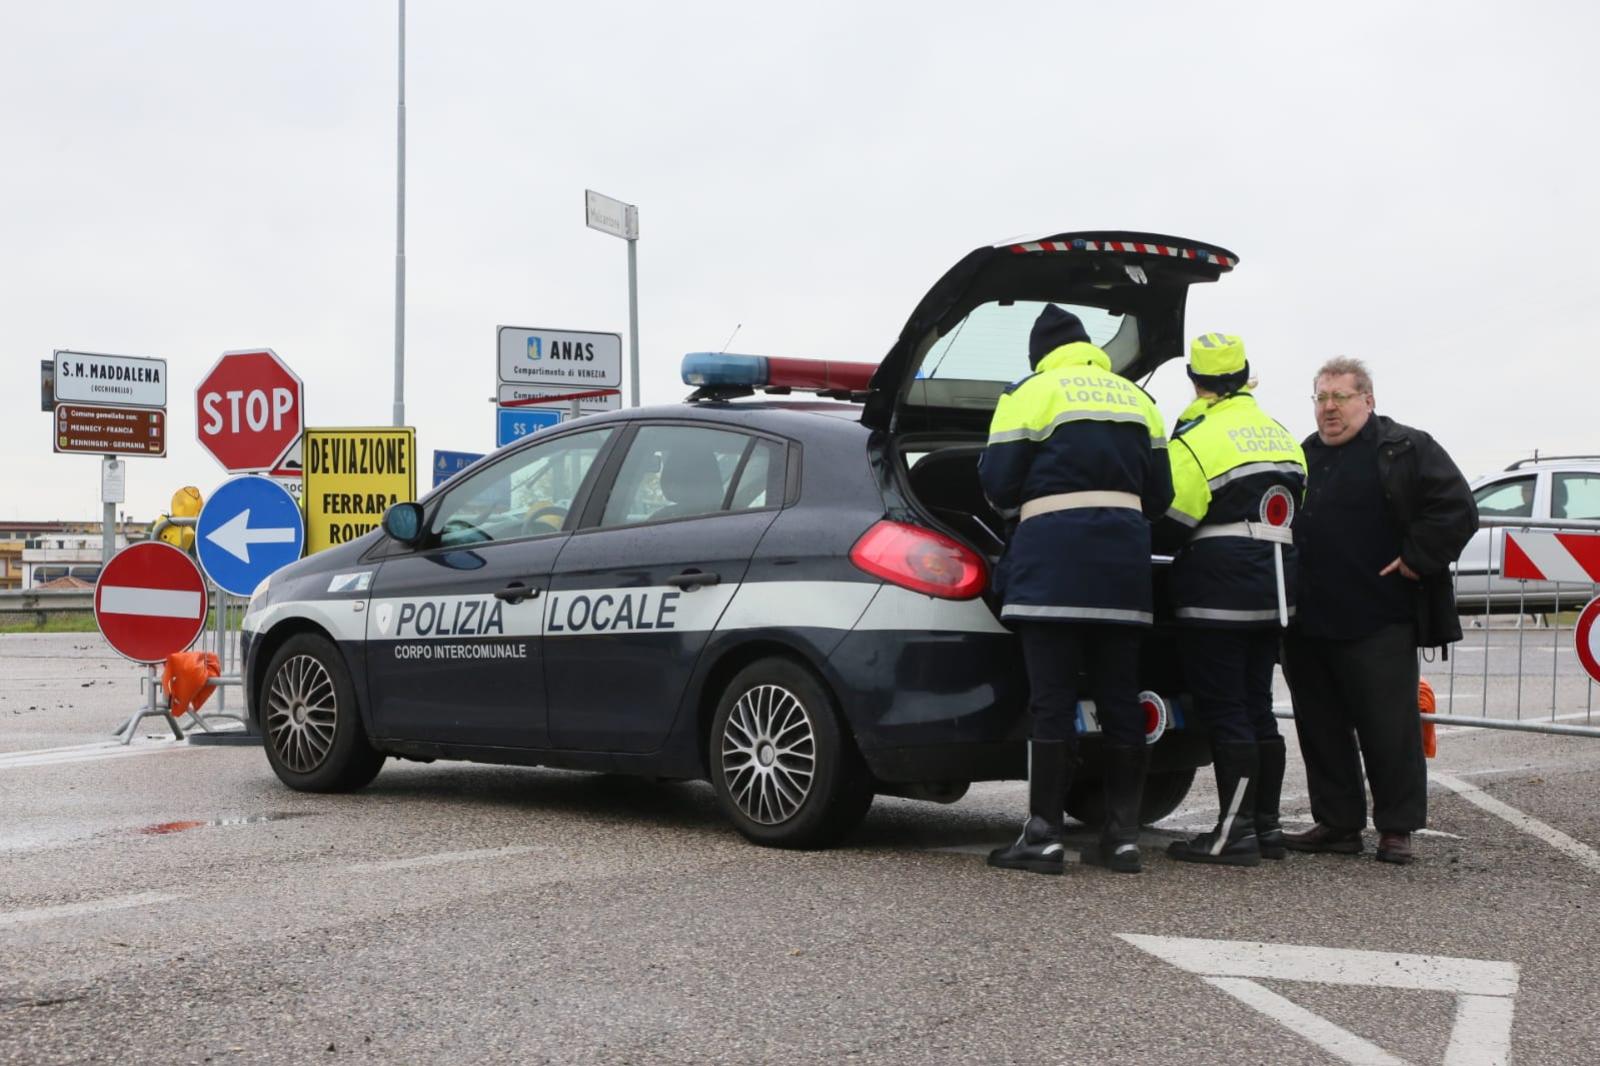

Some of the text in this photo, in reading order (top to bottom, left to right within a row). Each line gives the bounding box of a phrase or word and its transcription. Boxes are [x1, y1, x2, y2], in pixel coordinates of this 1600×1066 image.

[550, 340, 594, 361] ANAS
[513, 366, 606, 378] Compartimento di VENEZIA
[1060, 377, 1131, 391] POLIZIA
[1066, 390, 1138, 407] LOCALE
[71, 410, 95, 418] Comune
[96, 412, 125, 421] gemellato
[203, 387, 294, 435] STOP
[106, 426, 134, 434] FRANCIA
[512, 422, 526, 435] SS
[1228, 426, 1289, 440] POLIZIA
[113, 440, 145, 449] GERMANIA
[1236, 440, 1295, 452] LOCALE
[310, 437, 406, 475] DEVIAZIONE
[396, 592, 681, 636] POLIZIA LOCALE
[394, 643, 527, 660] CORPO INTERCOMUNALE
